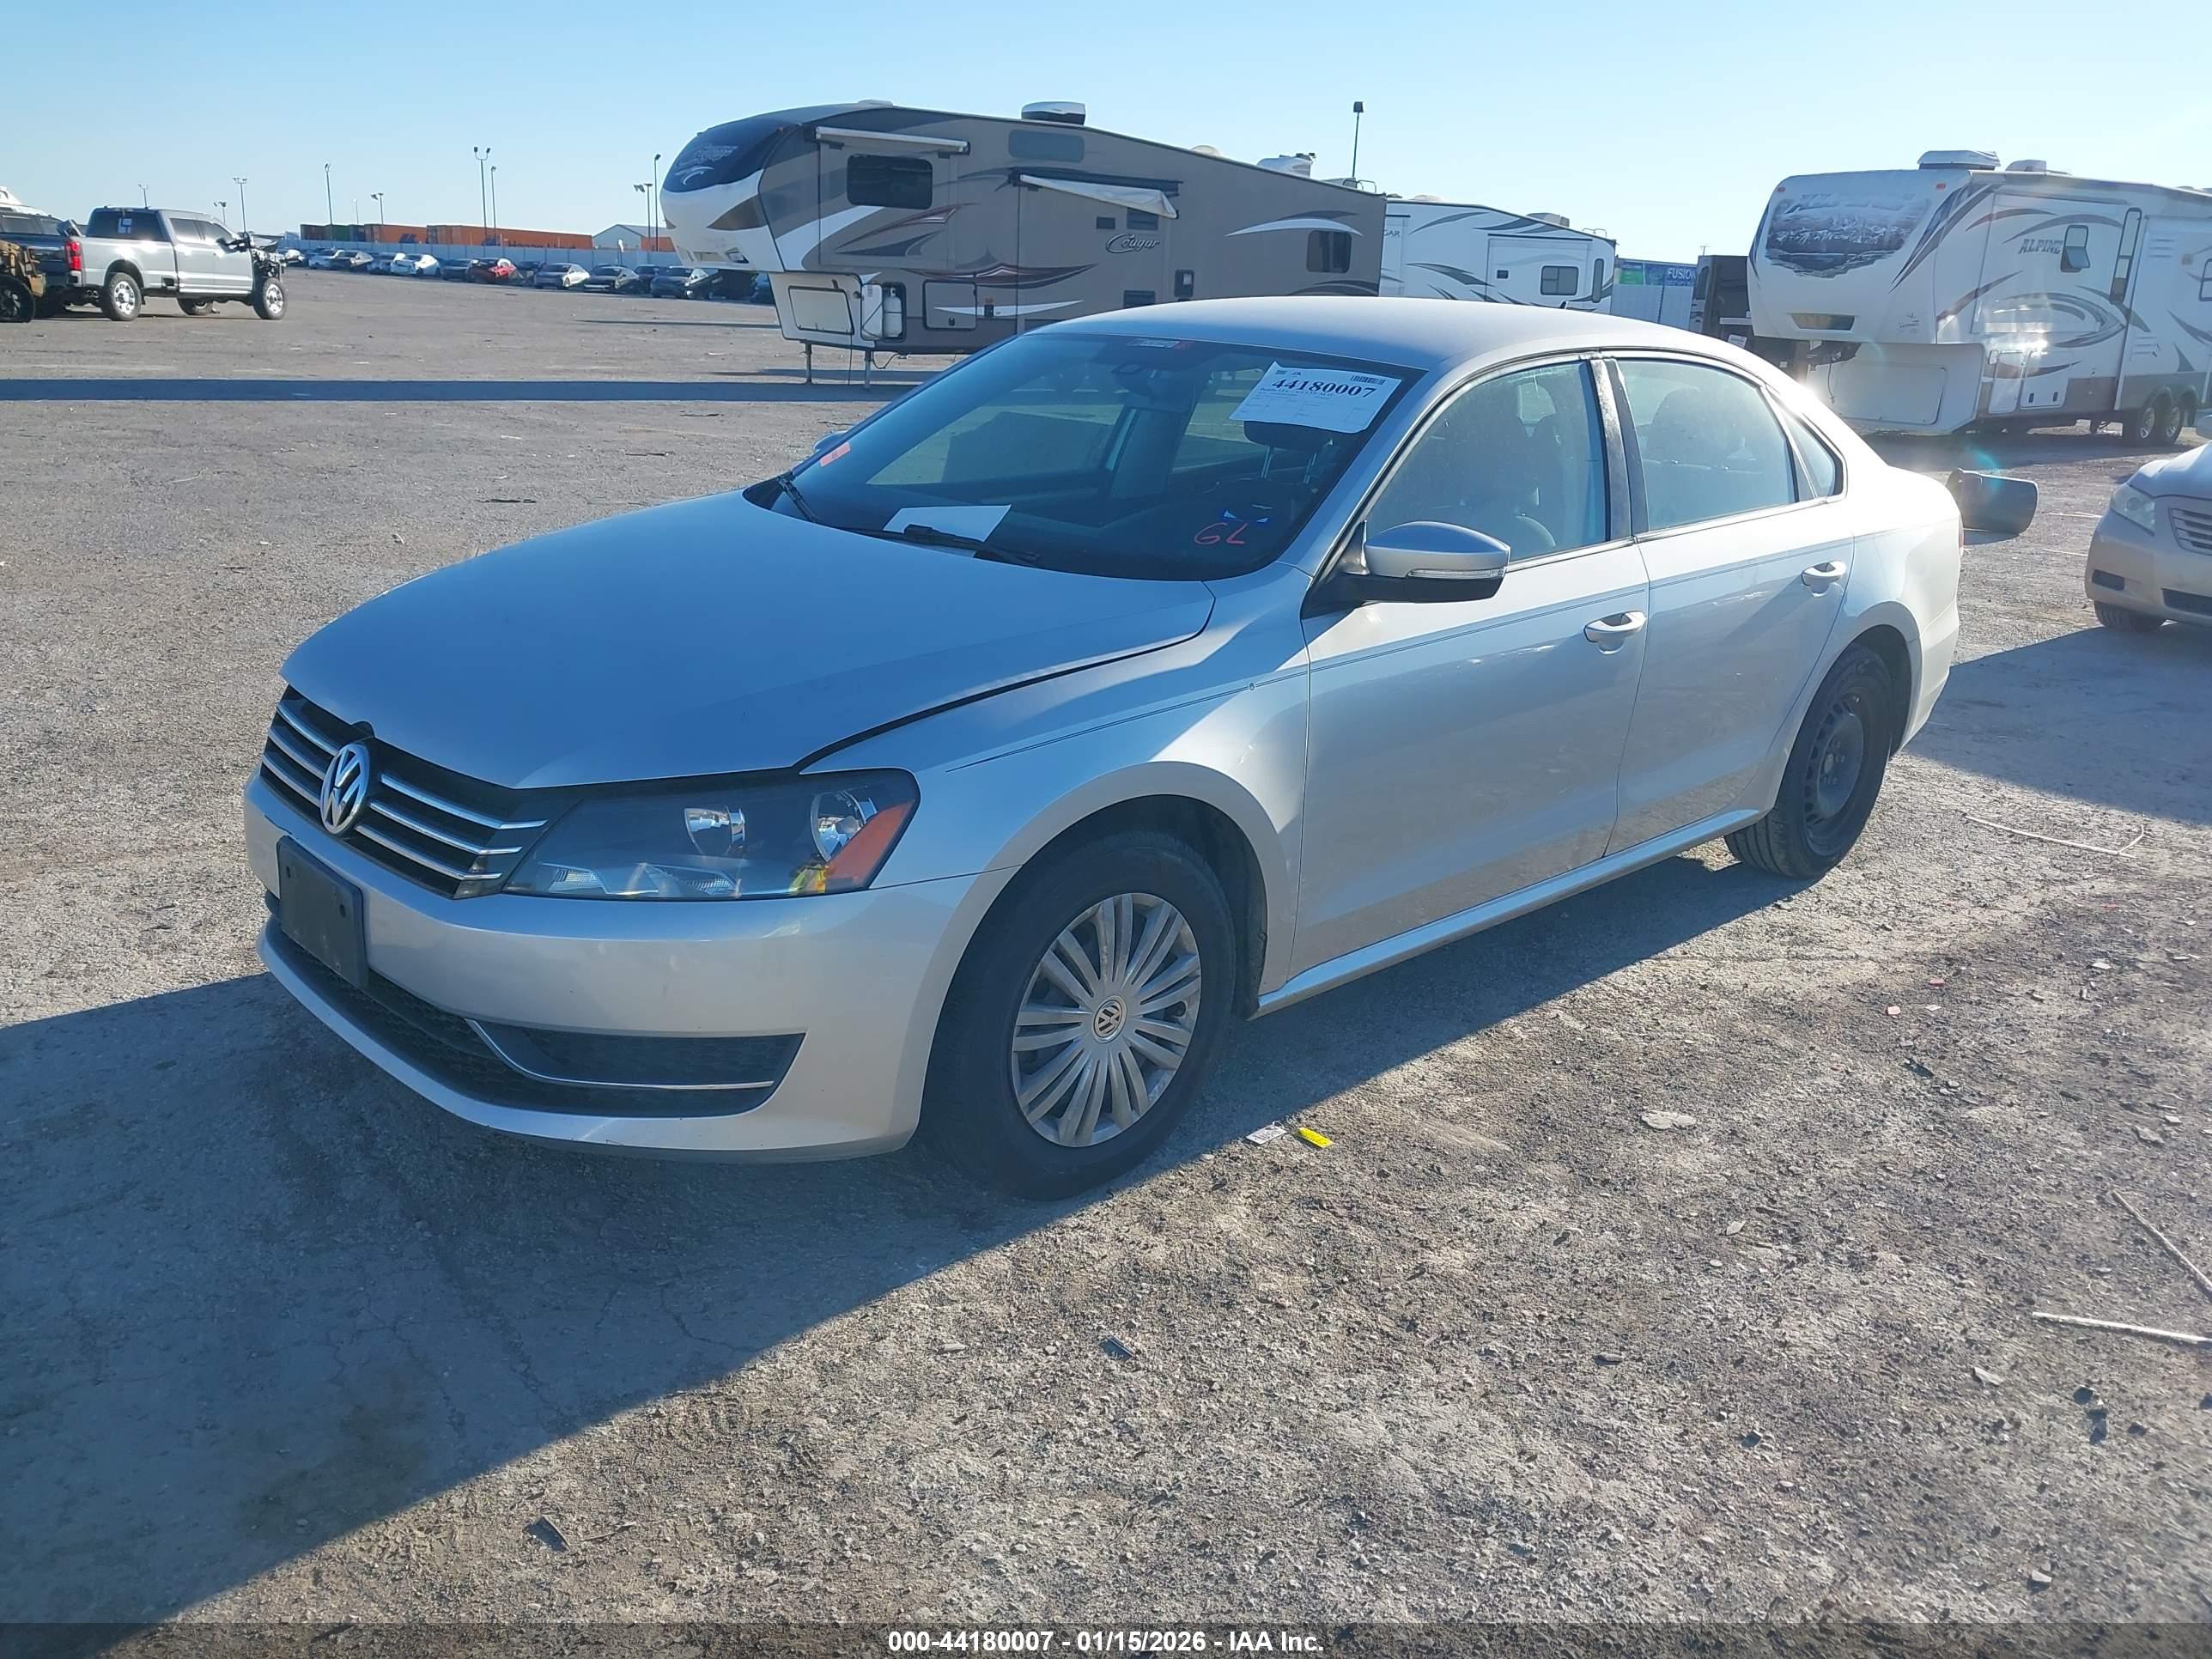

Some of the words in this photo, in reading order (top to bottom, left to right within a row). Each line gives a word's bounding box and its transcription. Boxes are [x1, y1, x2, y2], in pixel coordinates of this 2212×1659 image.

[1106, 233, 1161, 253] Cougar
[2018, 239, 2063, 254] ALPINE
[1272, 379, 1377, 398] 44180007
